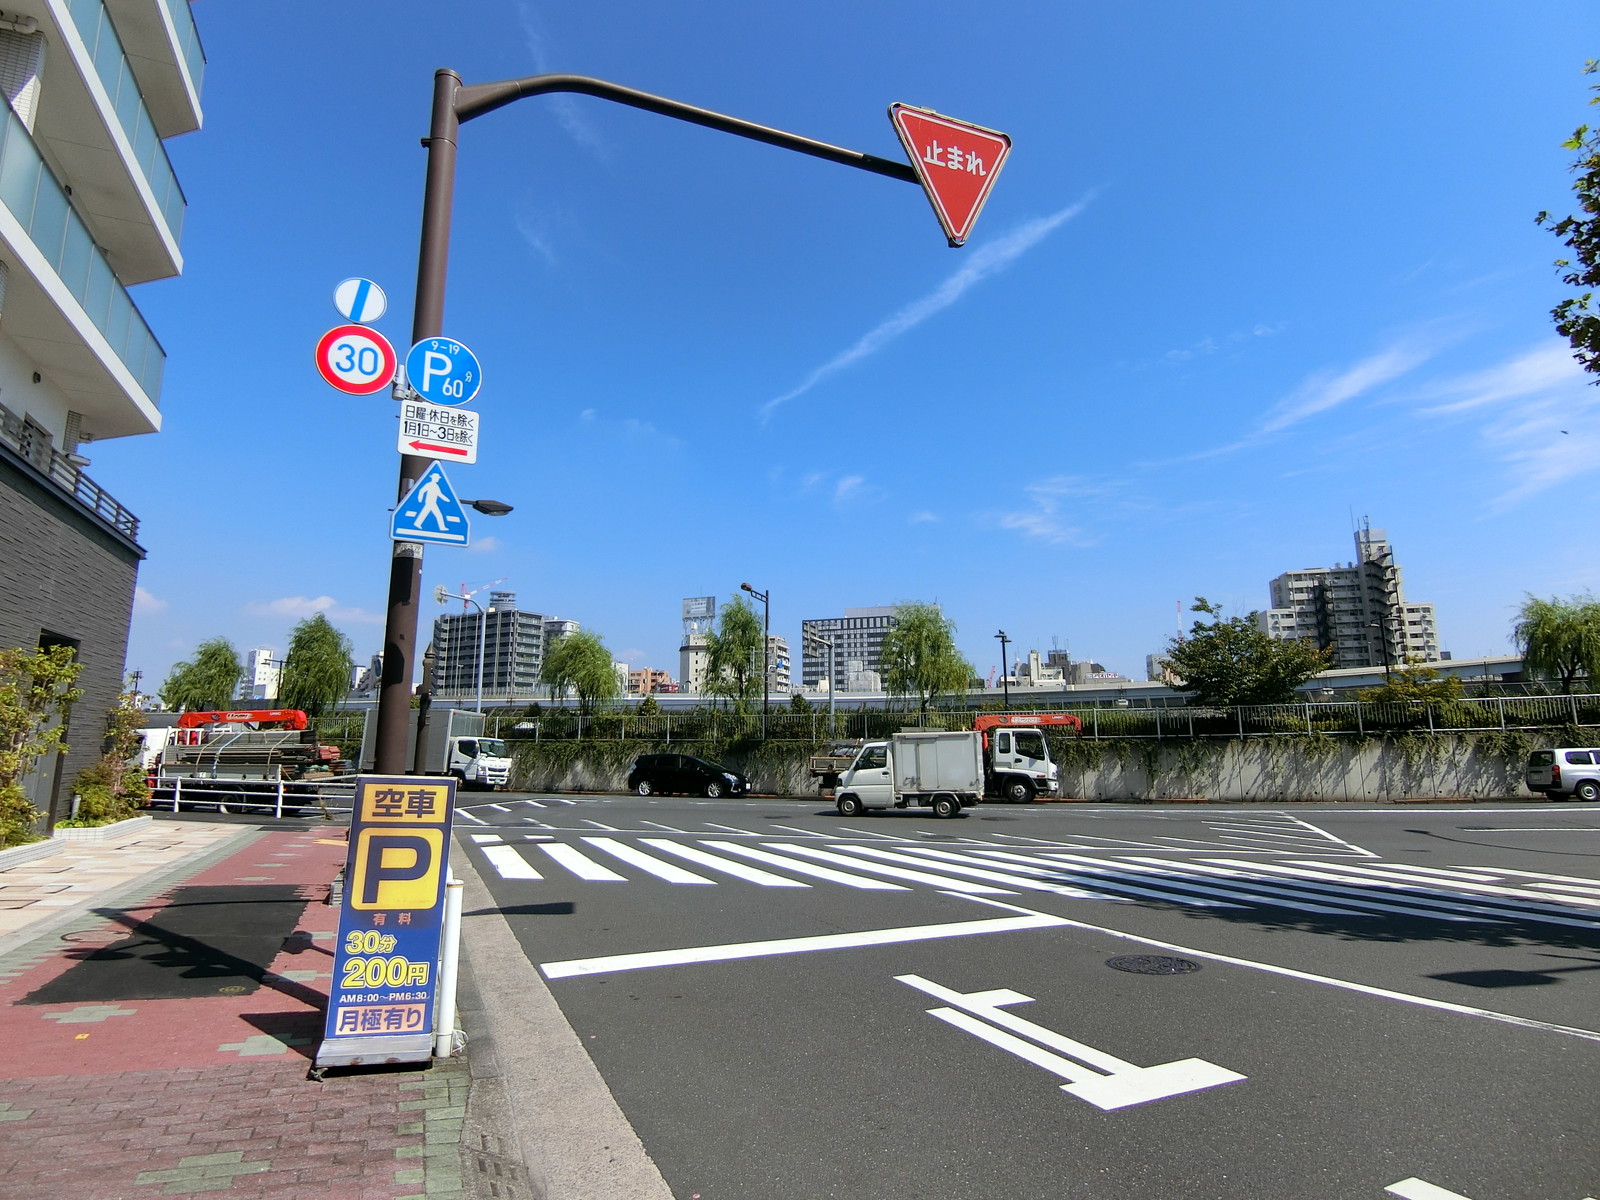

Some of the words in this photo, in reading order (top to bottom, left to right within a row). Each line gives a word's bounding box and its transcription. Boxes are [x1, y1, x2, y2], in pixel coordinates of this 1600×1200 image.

[923, 140, 987, 177] 止まれ
[335, 343, 379, 376] 30
[422, 350, 453, 392] P
[372, 788, 437, 818] 空車
[362, 835, 432, 904] P
[345, 930, 397, 955] 30分
[340, 956, 430, 989] 200円
[339, 1008, 422, 1032] 月極有り
